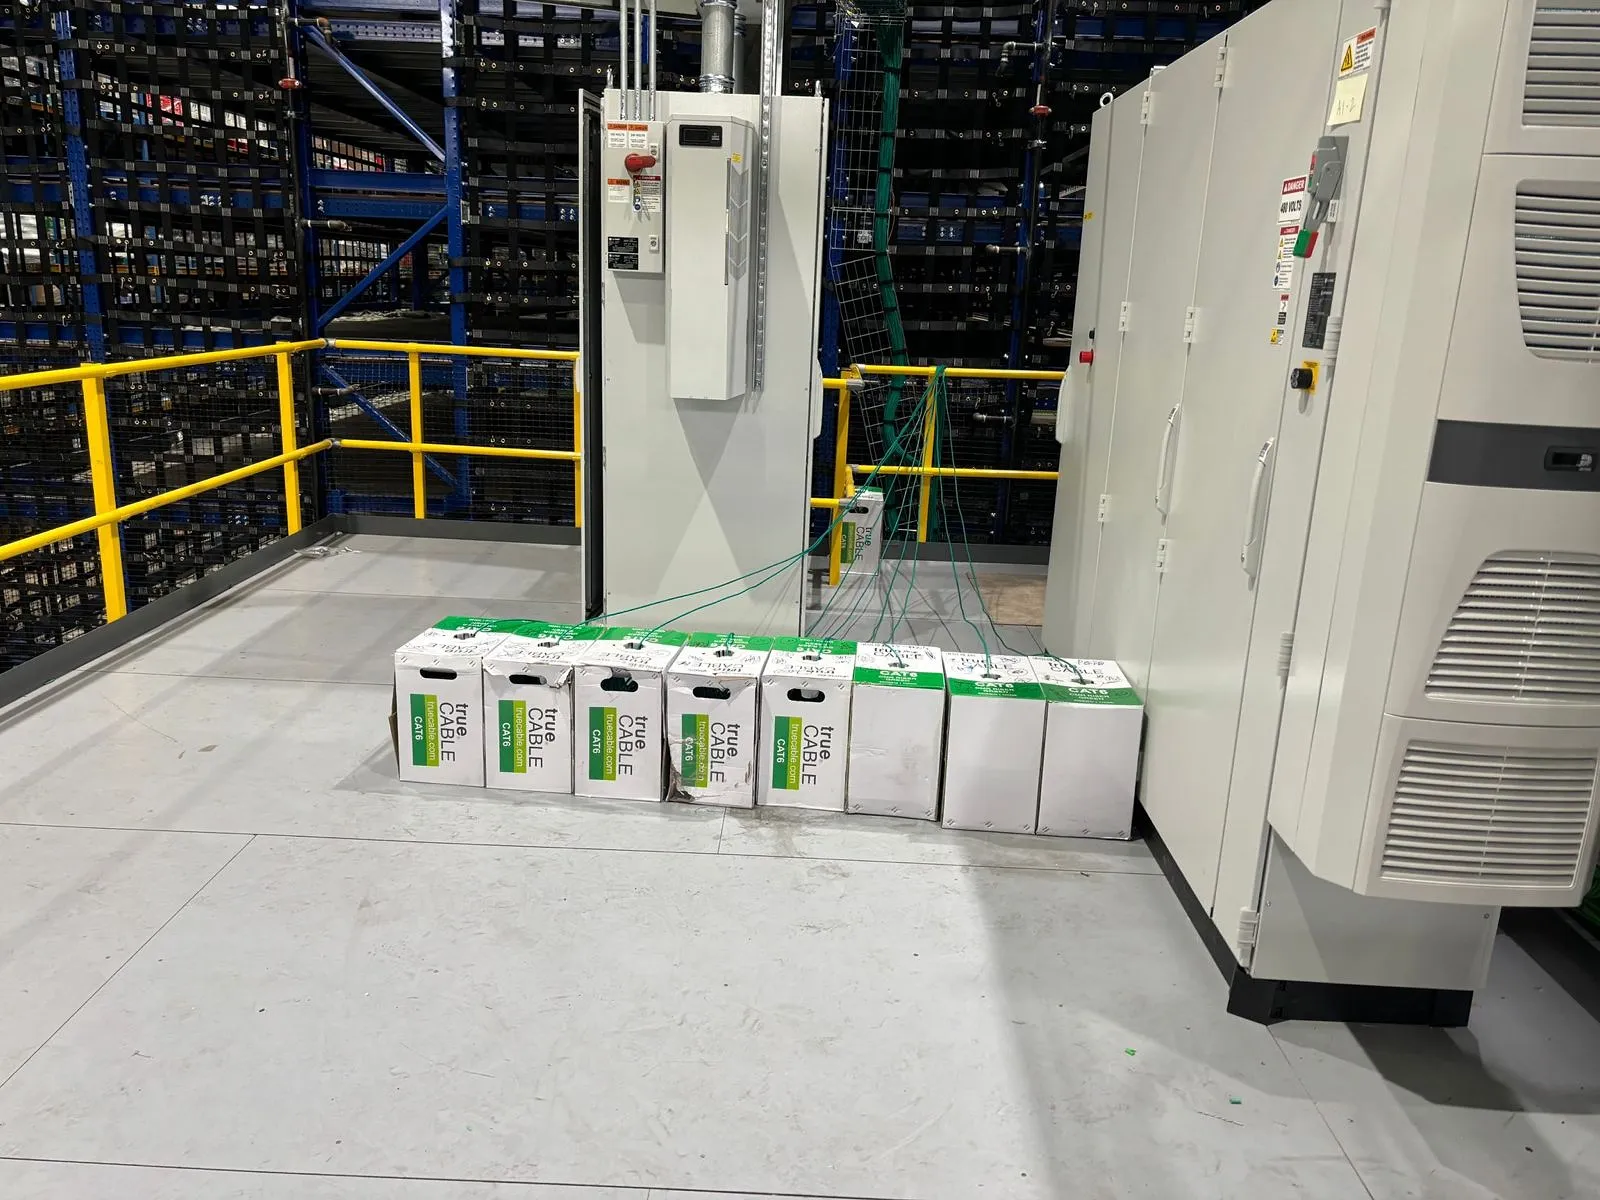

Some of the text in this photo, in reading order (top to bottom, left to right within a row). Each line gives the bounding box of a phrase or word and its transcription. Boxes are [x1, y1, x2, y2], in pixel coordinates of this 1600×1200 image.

[1288, 180, 1306, 192] DANGER
[1288, 200, 1302, 212] VOLTS
[855, 526, 865, 561] CABLE
[1068, 687, 1108, 695] CAT6
[414, 716, 423, 741] CAT6
[427, 701, 436, 761] truecable.com
[439, 702, 456, 762] CABLE
[455, 703, 468, 738] true
[502, 722, 511, 747] CAT6
[515, 707, 524, 768] truecable.com
[528, 707, 543, 768] CABLE
[545, 708, 558, 743] true
[635, 715, 648, 750] true
[592, 729, 600, 754] CAT6
[605, 714, 613, 775] truecable.com
[618, 714, 633, 775] CABLE
[684, 737, 693, 761] CAT6
[709, 722, 725, 783] CABLE
[727, 723, 740, 757] true
[776, 738, 785, 763] CAT6
[789, 723, 799, 784] truecable.com
[801, 725, 818, 785] CABLE
[820, 726, 834, 760] true
